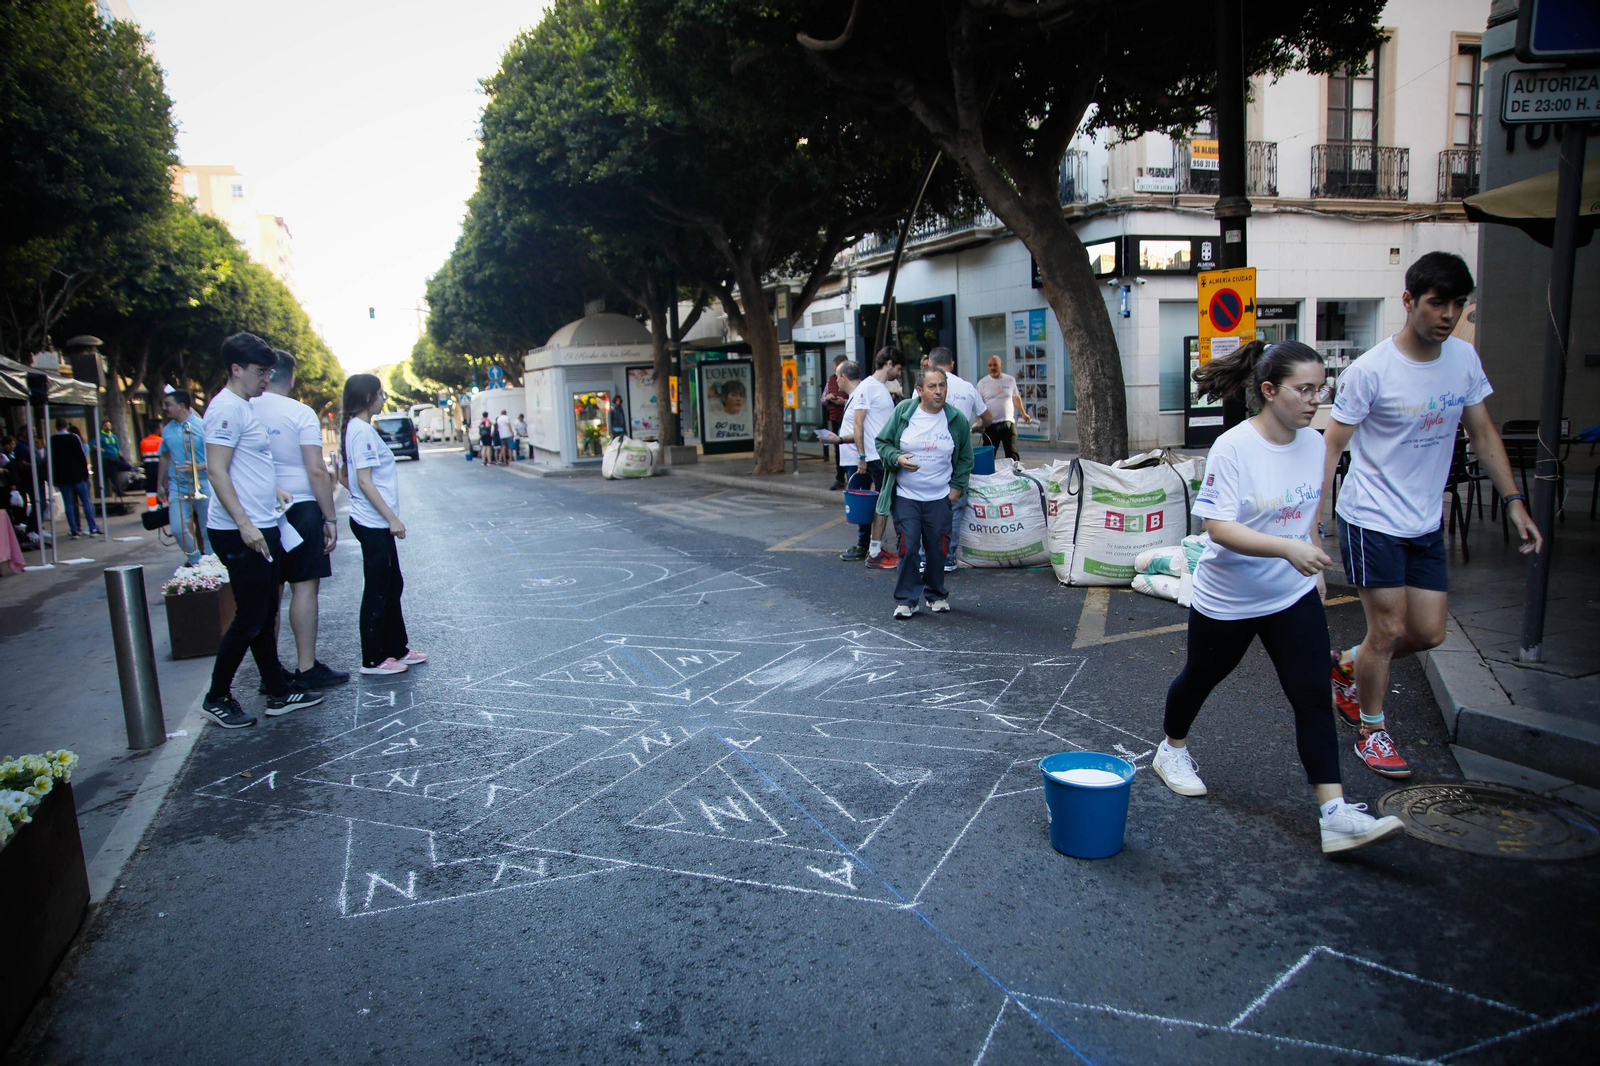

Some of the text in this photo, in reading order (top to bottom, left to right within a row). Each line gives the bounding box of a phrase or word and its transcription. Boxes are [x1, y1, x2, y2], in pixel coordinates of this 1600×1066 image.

[1513, 76, 1599, 94] AUTORIZA
[1511, 100, 1530, 112] DE
[1535, 98, 1571, 112] 23:00
[1576, 97, 1590, 111] H.
[1201, 146, 1219, 155] ALQUI
[1193, 159, 1204, 168] 950
[1209, 275, 1253, 284] ALMERÍA CIUDAD
[705, 366, 747, 380] LOEWE
[1428, 397, 1437, 410] de
[1286, 489, 1294, 503] de
[968, 522, 1024, 534] ORTIGOSA
[1108, 513, 1161, 531] BdB
[1133, 540, 1163, 549] especialista
